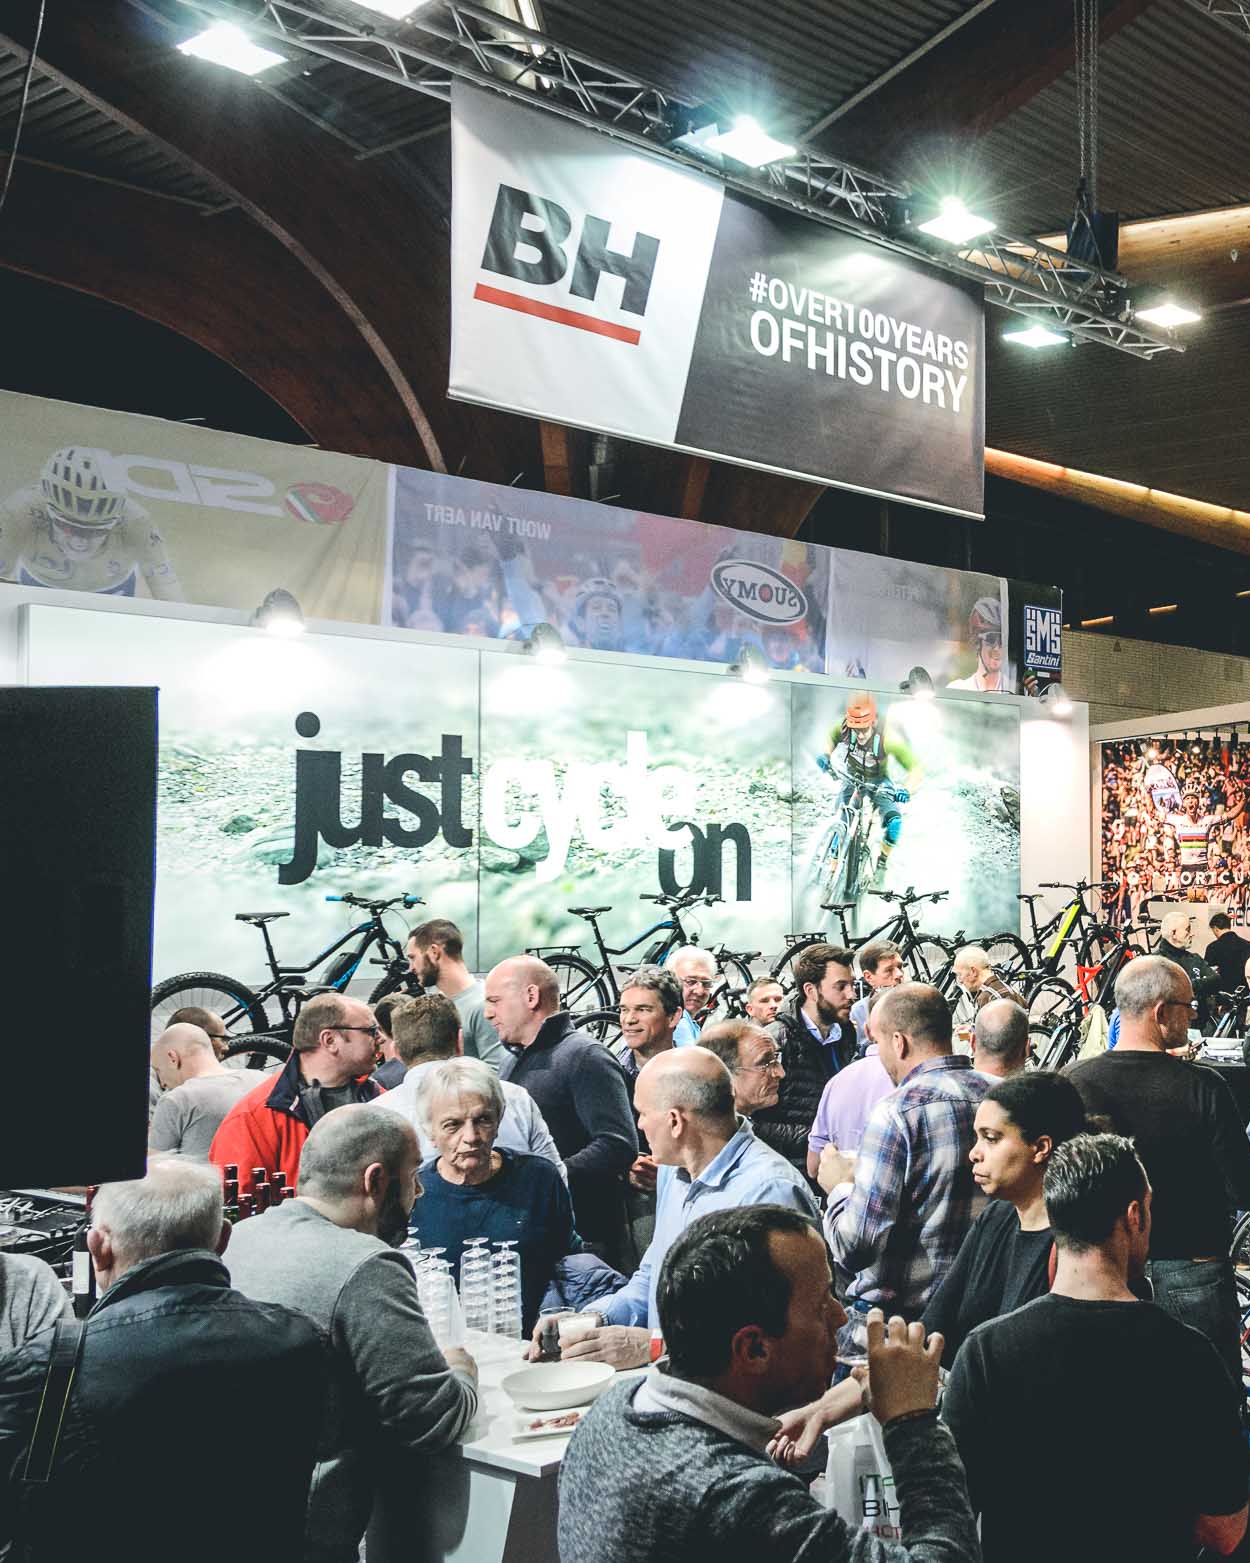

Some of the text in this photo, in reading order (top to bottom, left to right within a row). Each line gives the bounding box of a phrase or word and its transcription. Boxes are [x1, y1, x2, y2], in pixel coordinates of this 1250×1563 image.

[480, 184, 660, 317] BH
[749, 272, 969, 369] #OVER100YEARS
[750, 311, 968, 412] OFHISTORY
[1026, 608, 1060, 654] SMS
[277, 711, 473, 886] just
[658, 821, 752, 902] on
